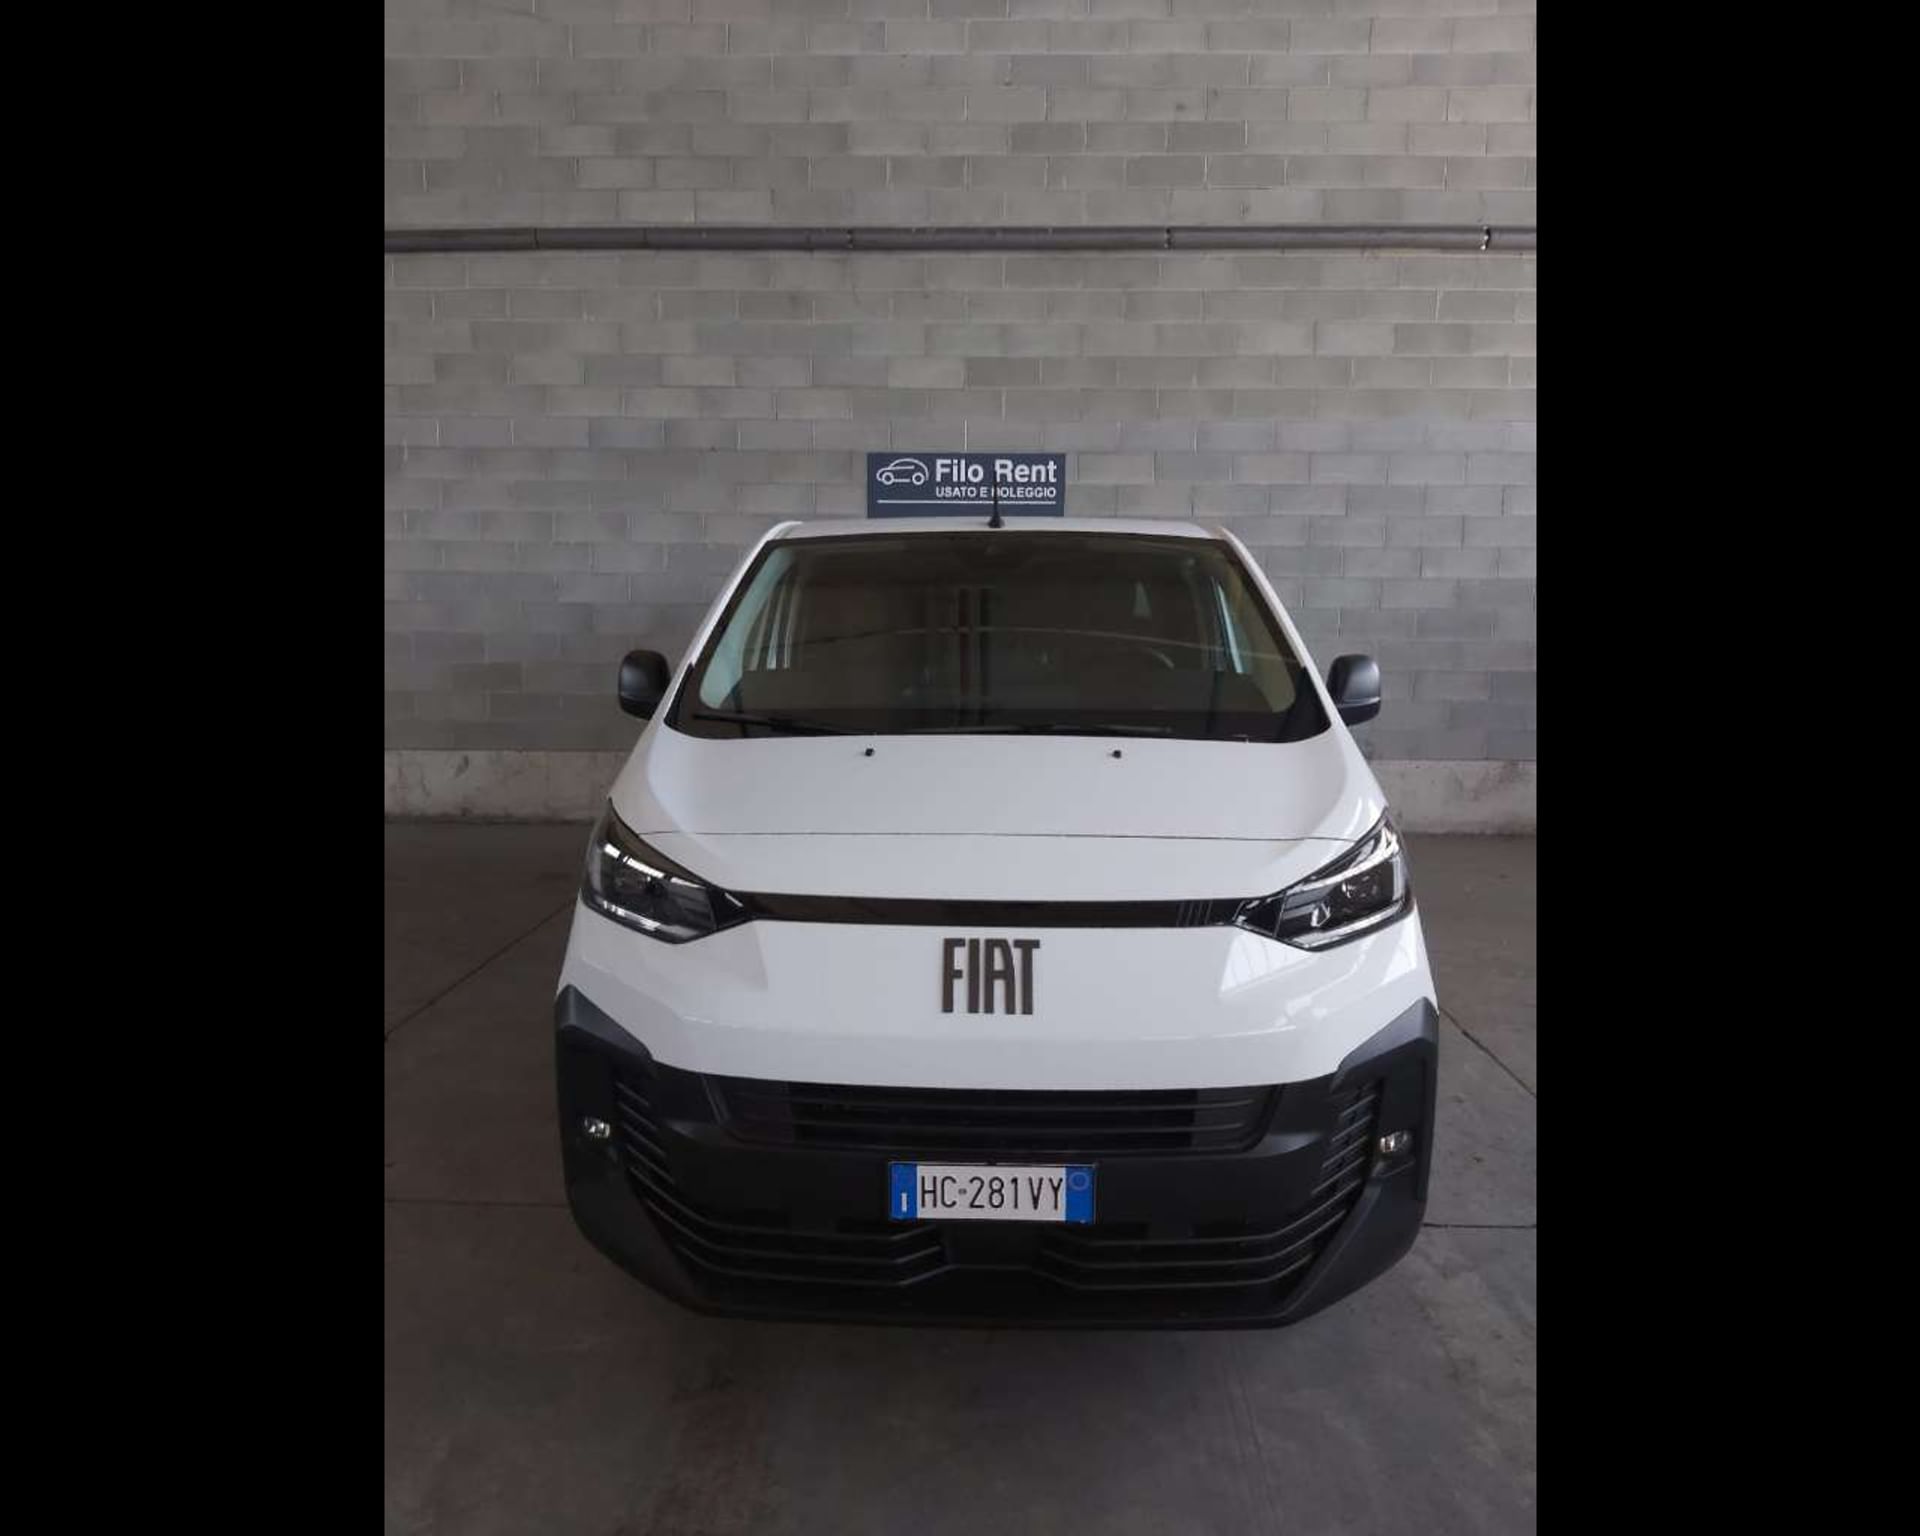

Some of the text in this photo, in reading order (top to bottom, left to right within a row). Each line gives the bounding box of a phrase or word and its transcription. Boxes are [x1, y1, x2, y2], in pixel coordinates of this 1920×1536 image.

[935, 459, 1057, 483] Filo Rent
[935, 487, 977, 498] USATO
[980, 487, 989, 498] E
[942, 938, 1040, 1015] FIAT
